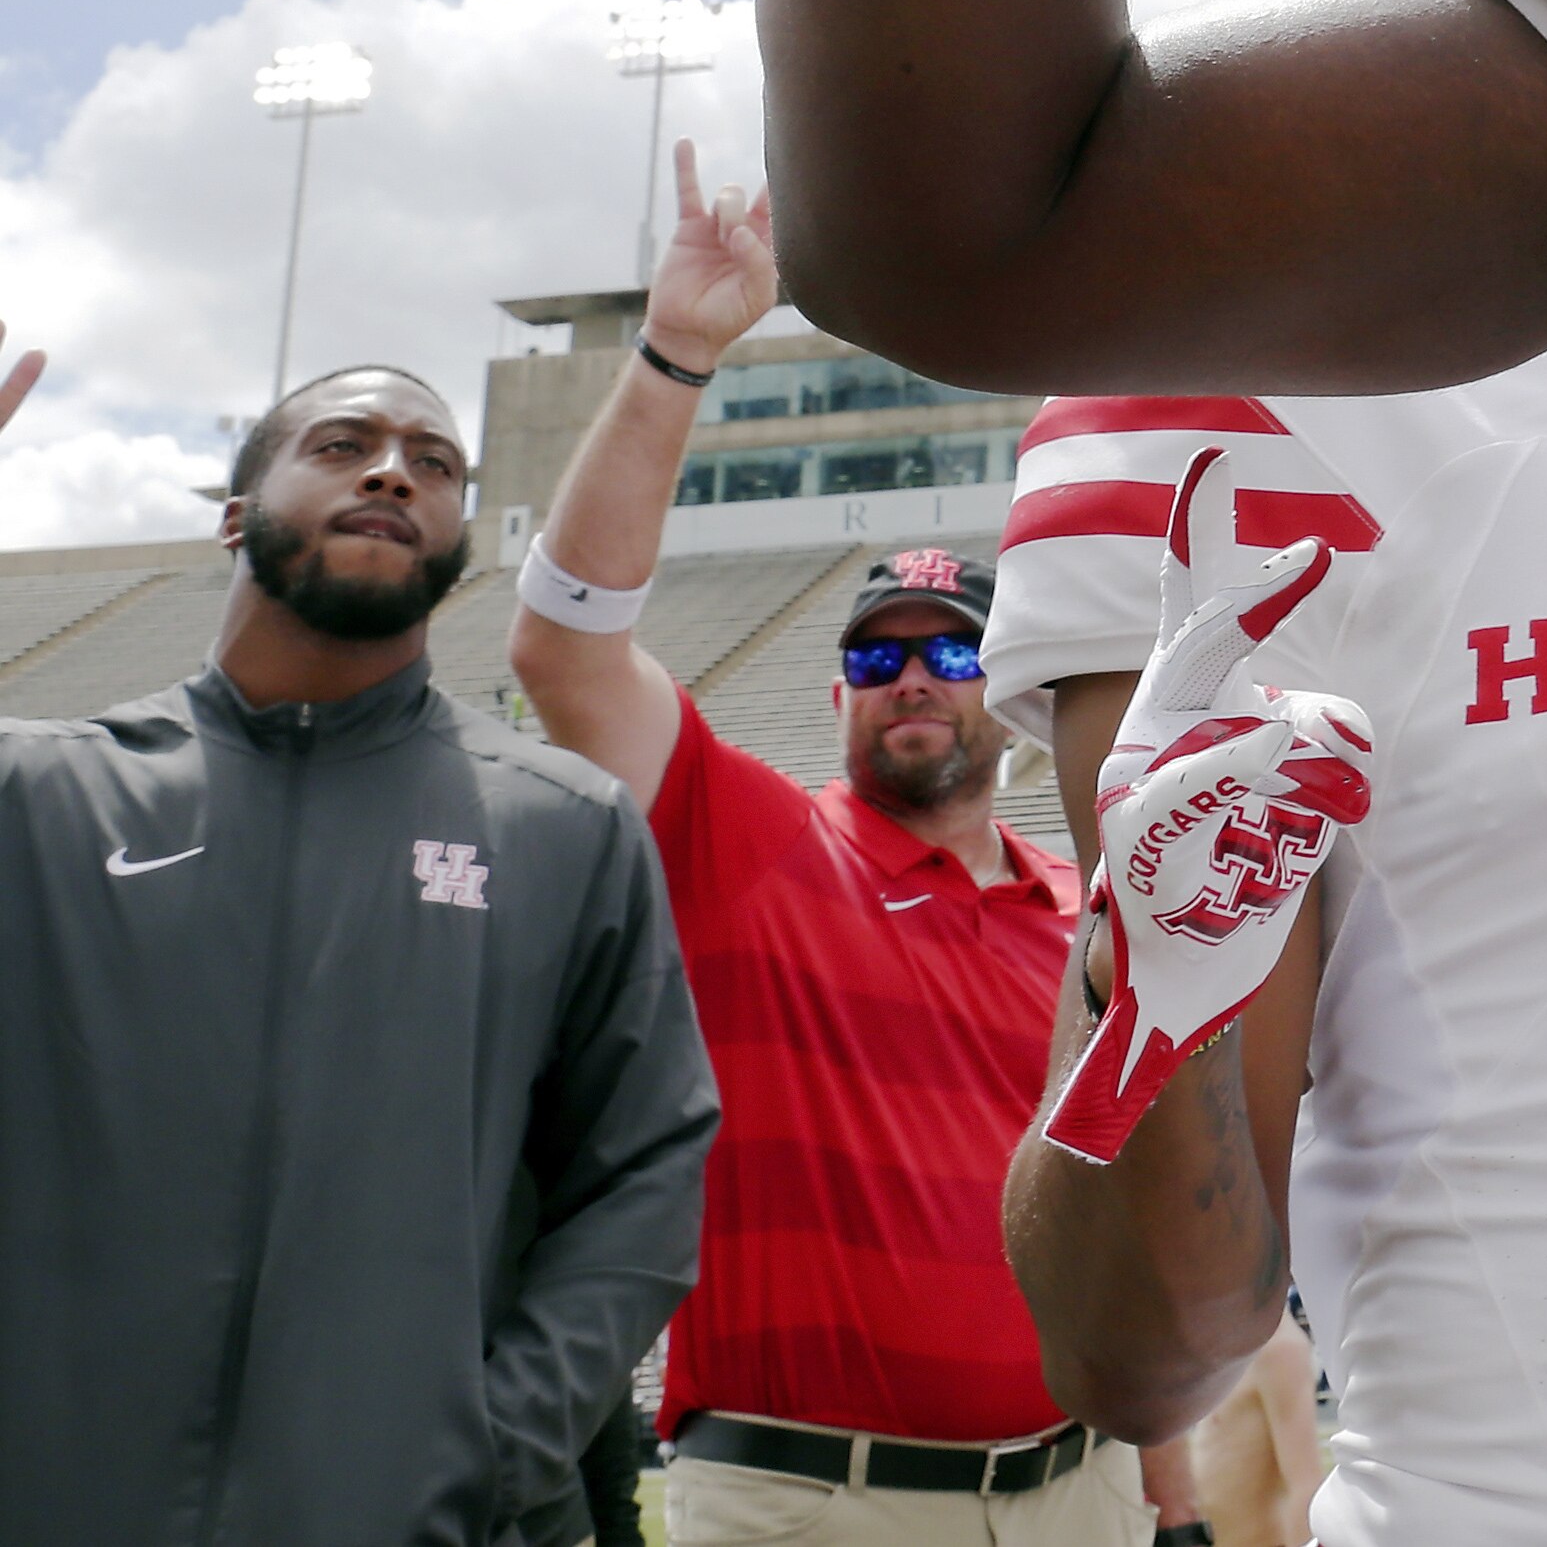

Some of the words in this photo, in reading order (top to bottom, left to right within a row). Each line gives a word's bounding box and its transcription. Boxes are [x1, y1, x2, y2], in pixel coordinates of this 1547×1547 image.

[893, 547, 965, 594] UH
[1127, 776, 1251, 896] COUGARS
[413, 839, 489, 909] UH
